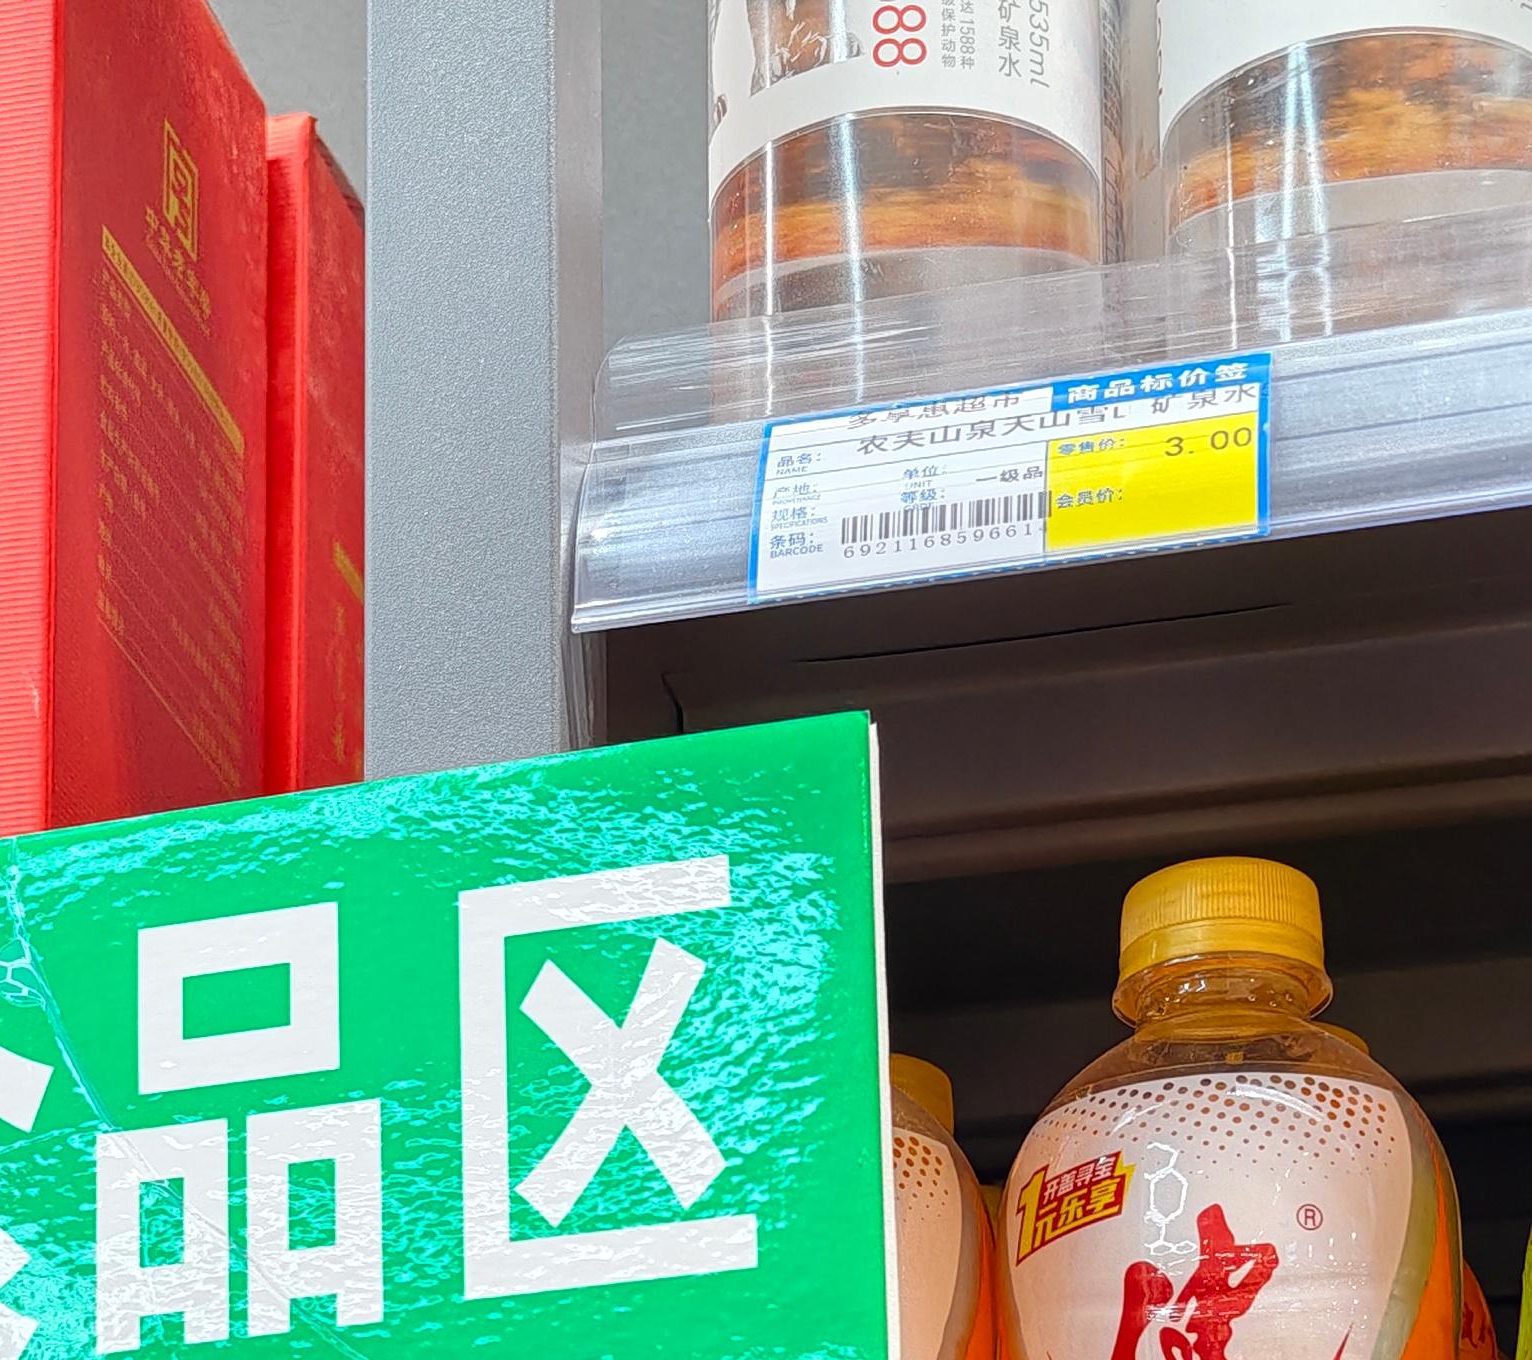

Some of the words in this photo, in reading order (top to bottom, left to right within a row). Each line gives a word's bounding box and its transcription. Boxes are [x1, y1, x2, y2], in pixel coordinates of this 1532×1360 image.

[998, 0, 1022, 77] 矿泉水
[1068, 362, 1249, 405] 商品标价签
[1058, 437, 1125, 456] 零售价：
[975, 466, 1044, 484] 一级品
